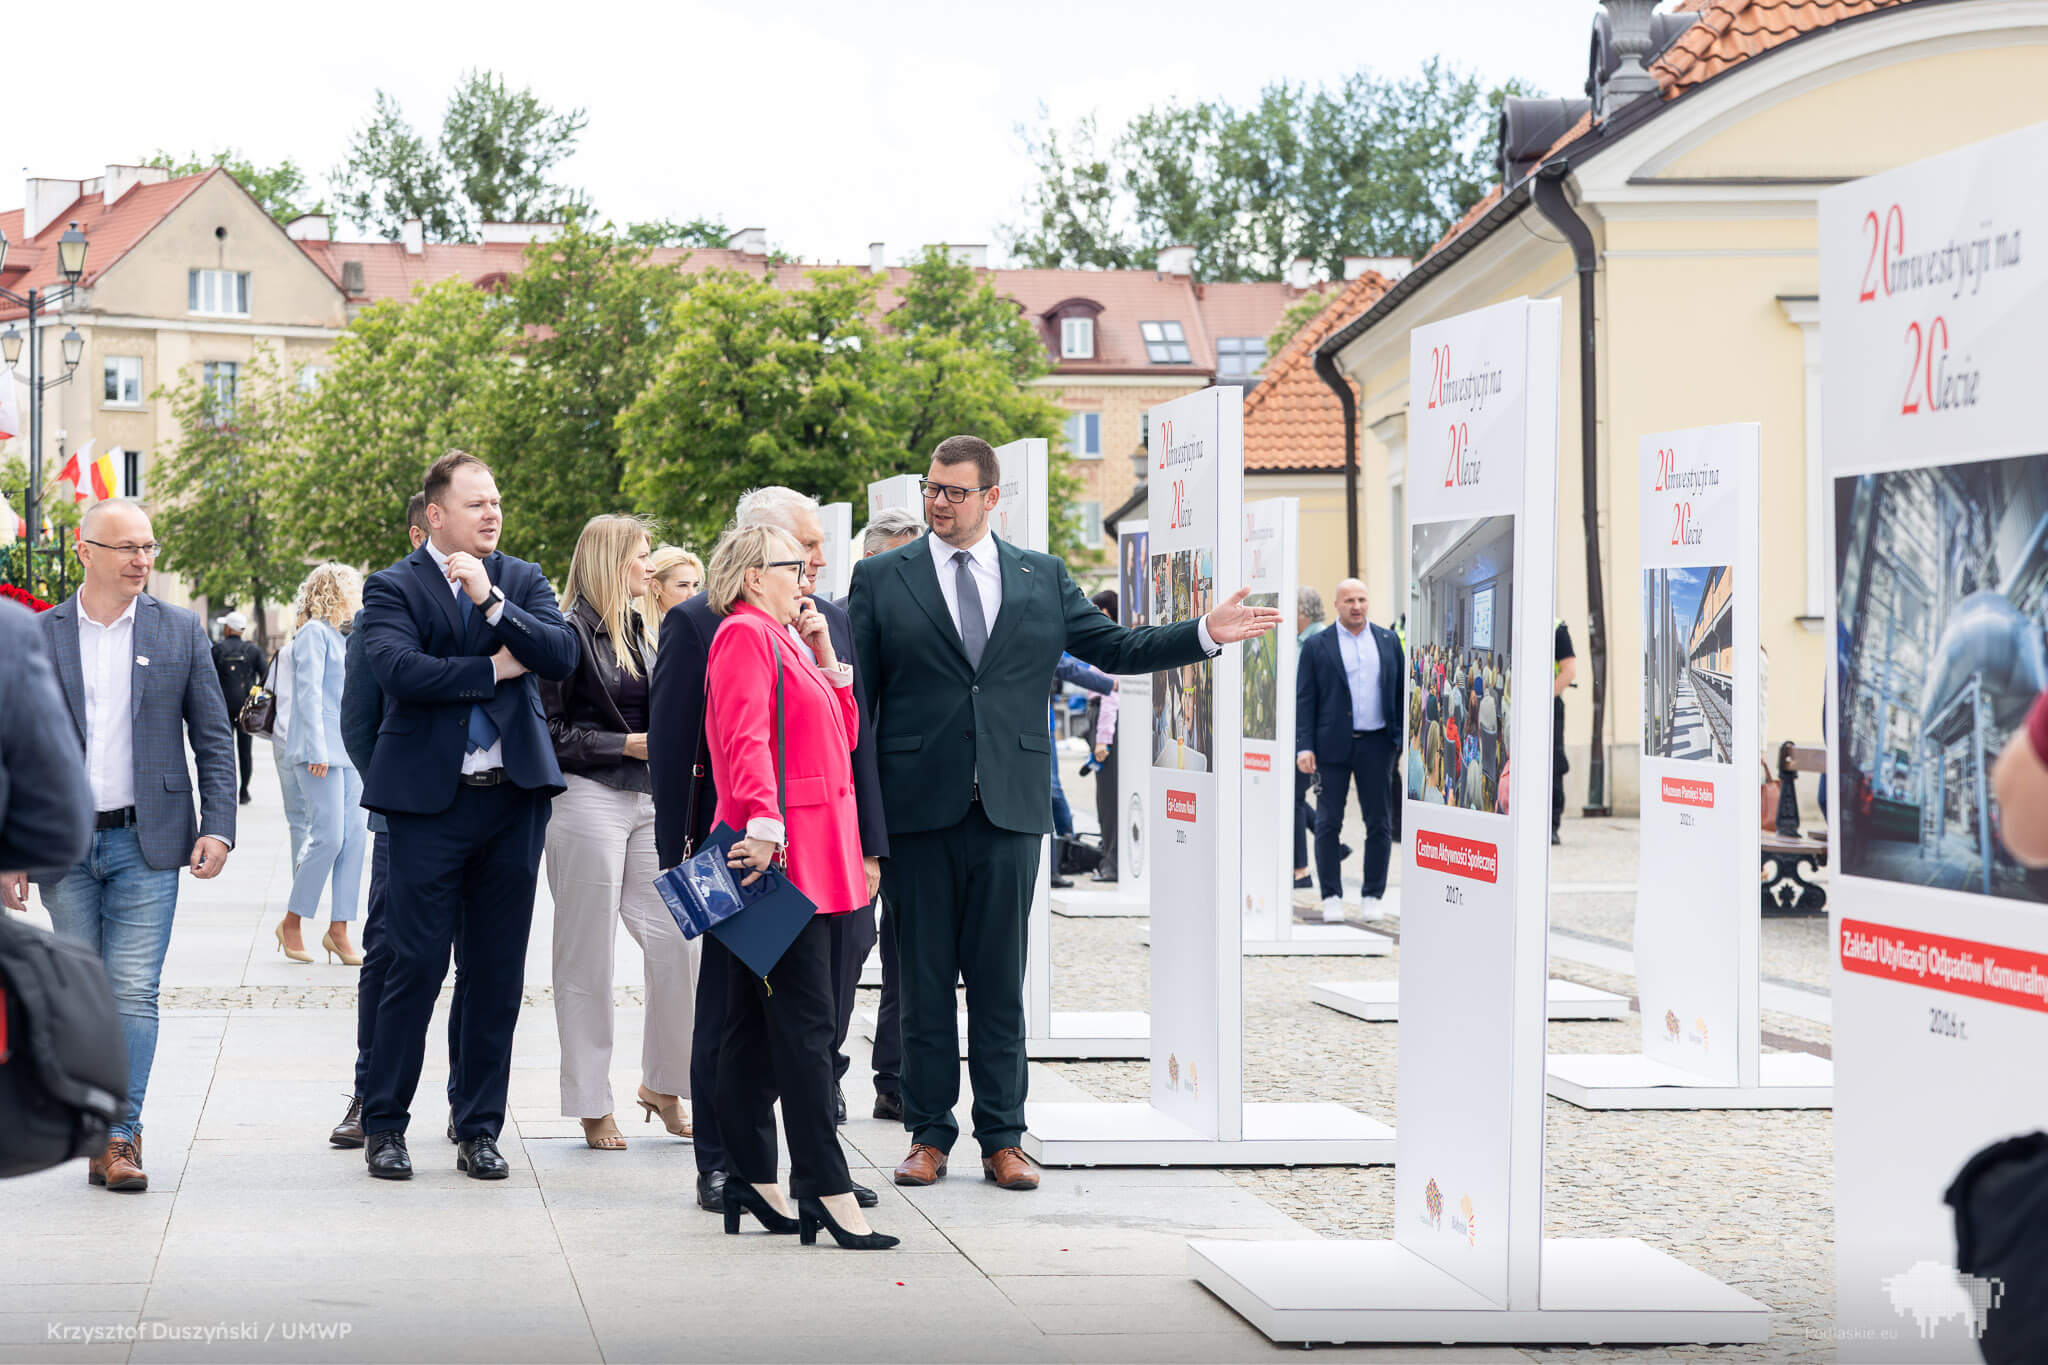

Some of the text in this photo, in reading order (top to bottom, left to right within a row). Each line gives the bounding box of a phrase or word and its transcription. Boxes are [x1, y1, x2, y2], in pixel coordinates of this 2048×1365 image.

[1995, 226, 2022, 268] na
[1417, 838, 1497, 877] Centrum Aktywności Społecznej
[1445, 885, 1459, 904] 2017
[1842, 931, 1878, 962] Zakład
[1878, 936, 1929, 978] Utylizacji
[1928, 946, 1984, 983] Odpadów
